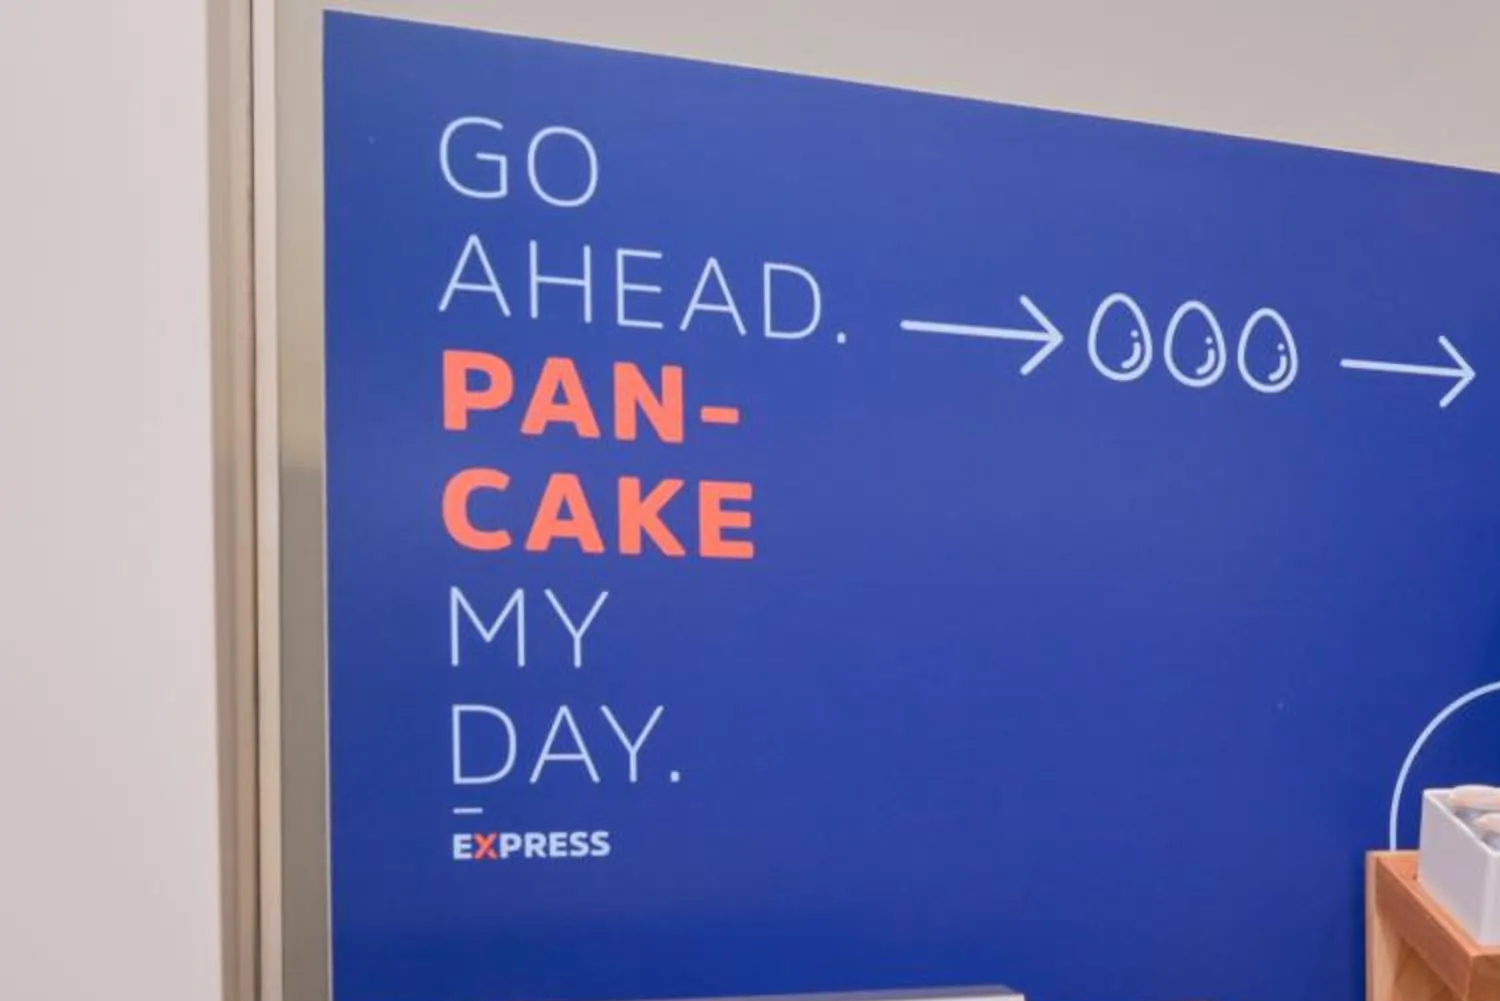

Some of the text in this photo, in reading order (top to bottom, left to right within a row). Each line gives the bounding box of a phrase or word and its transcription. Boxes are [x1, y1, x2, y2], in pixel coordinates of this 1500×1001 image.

[439, 116, 599, 208] GO
[438, 234, 847, 344] AHEAD.
[442, 348, 740, 444] PAN-
[441, 467, 755, 559] CAKE
[450, 585, 609, 668] MY
[452, 704, 680, 785] DAY.
[453, 830, 611, 860] EXPRESS
